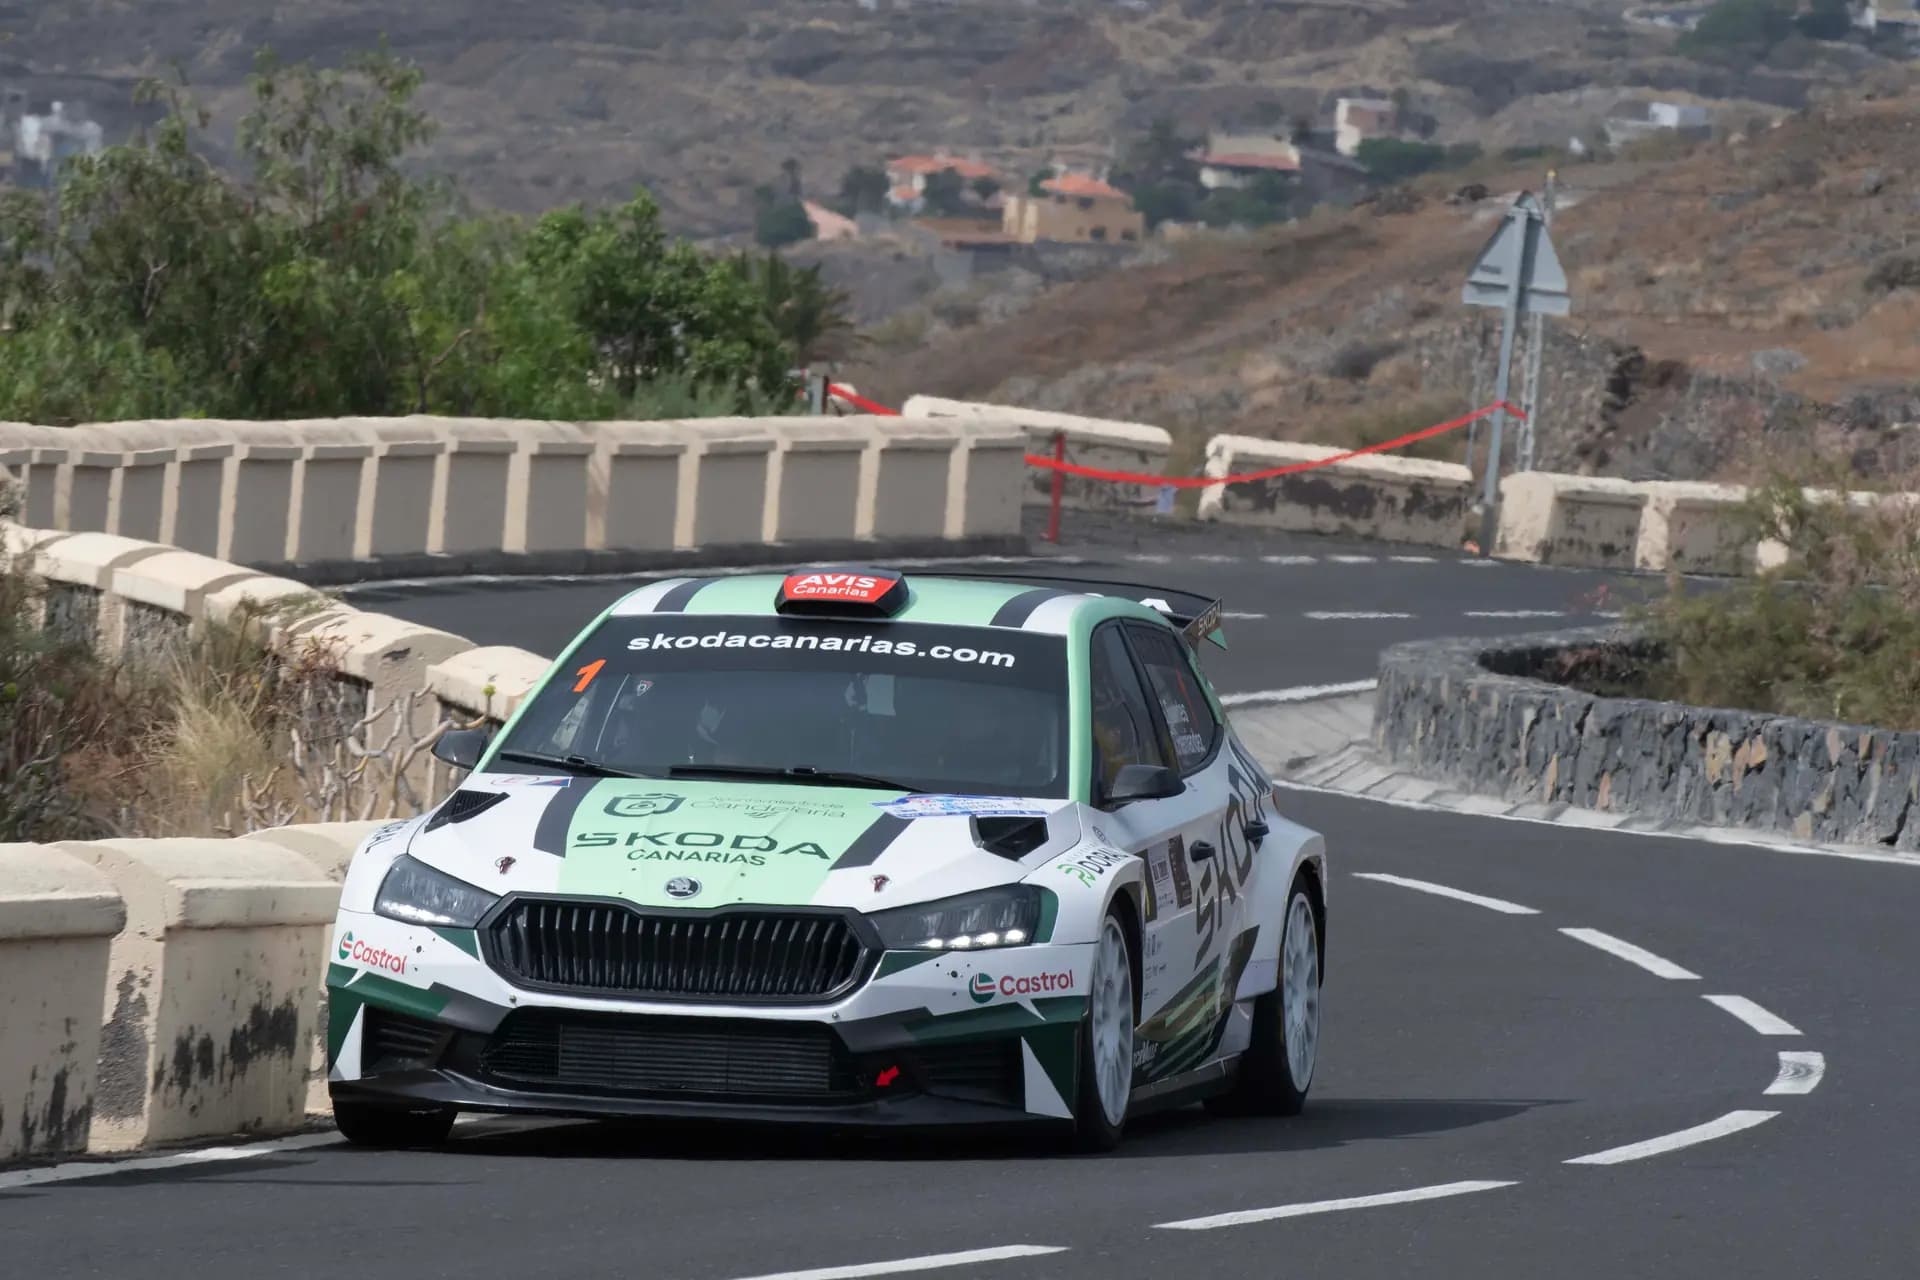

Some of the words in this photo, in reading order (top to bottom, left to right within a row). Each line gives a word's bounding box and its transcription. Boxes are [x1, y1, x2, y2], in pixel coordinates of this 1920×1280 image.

[793, 585, 868, 597] Canarias
[798, 575, 877, 588] AVIS
[627, 632, 1015, 667] skodacanarias.com
[573, 659, 607, 692] 1
[572, 832, 831, 860] SKODA
[627, 849, 766, 866] CANARIAS
[353, 940, 407, 975] Castrol
[1000, 969, 1074, 996] Castrol
